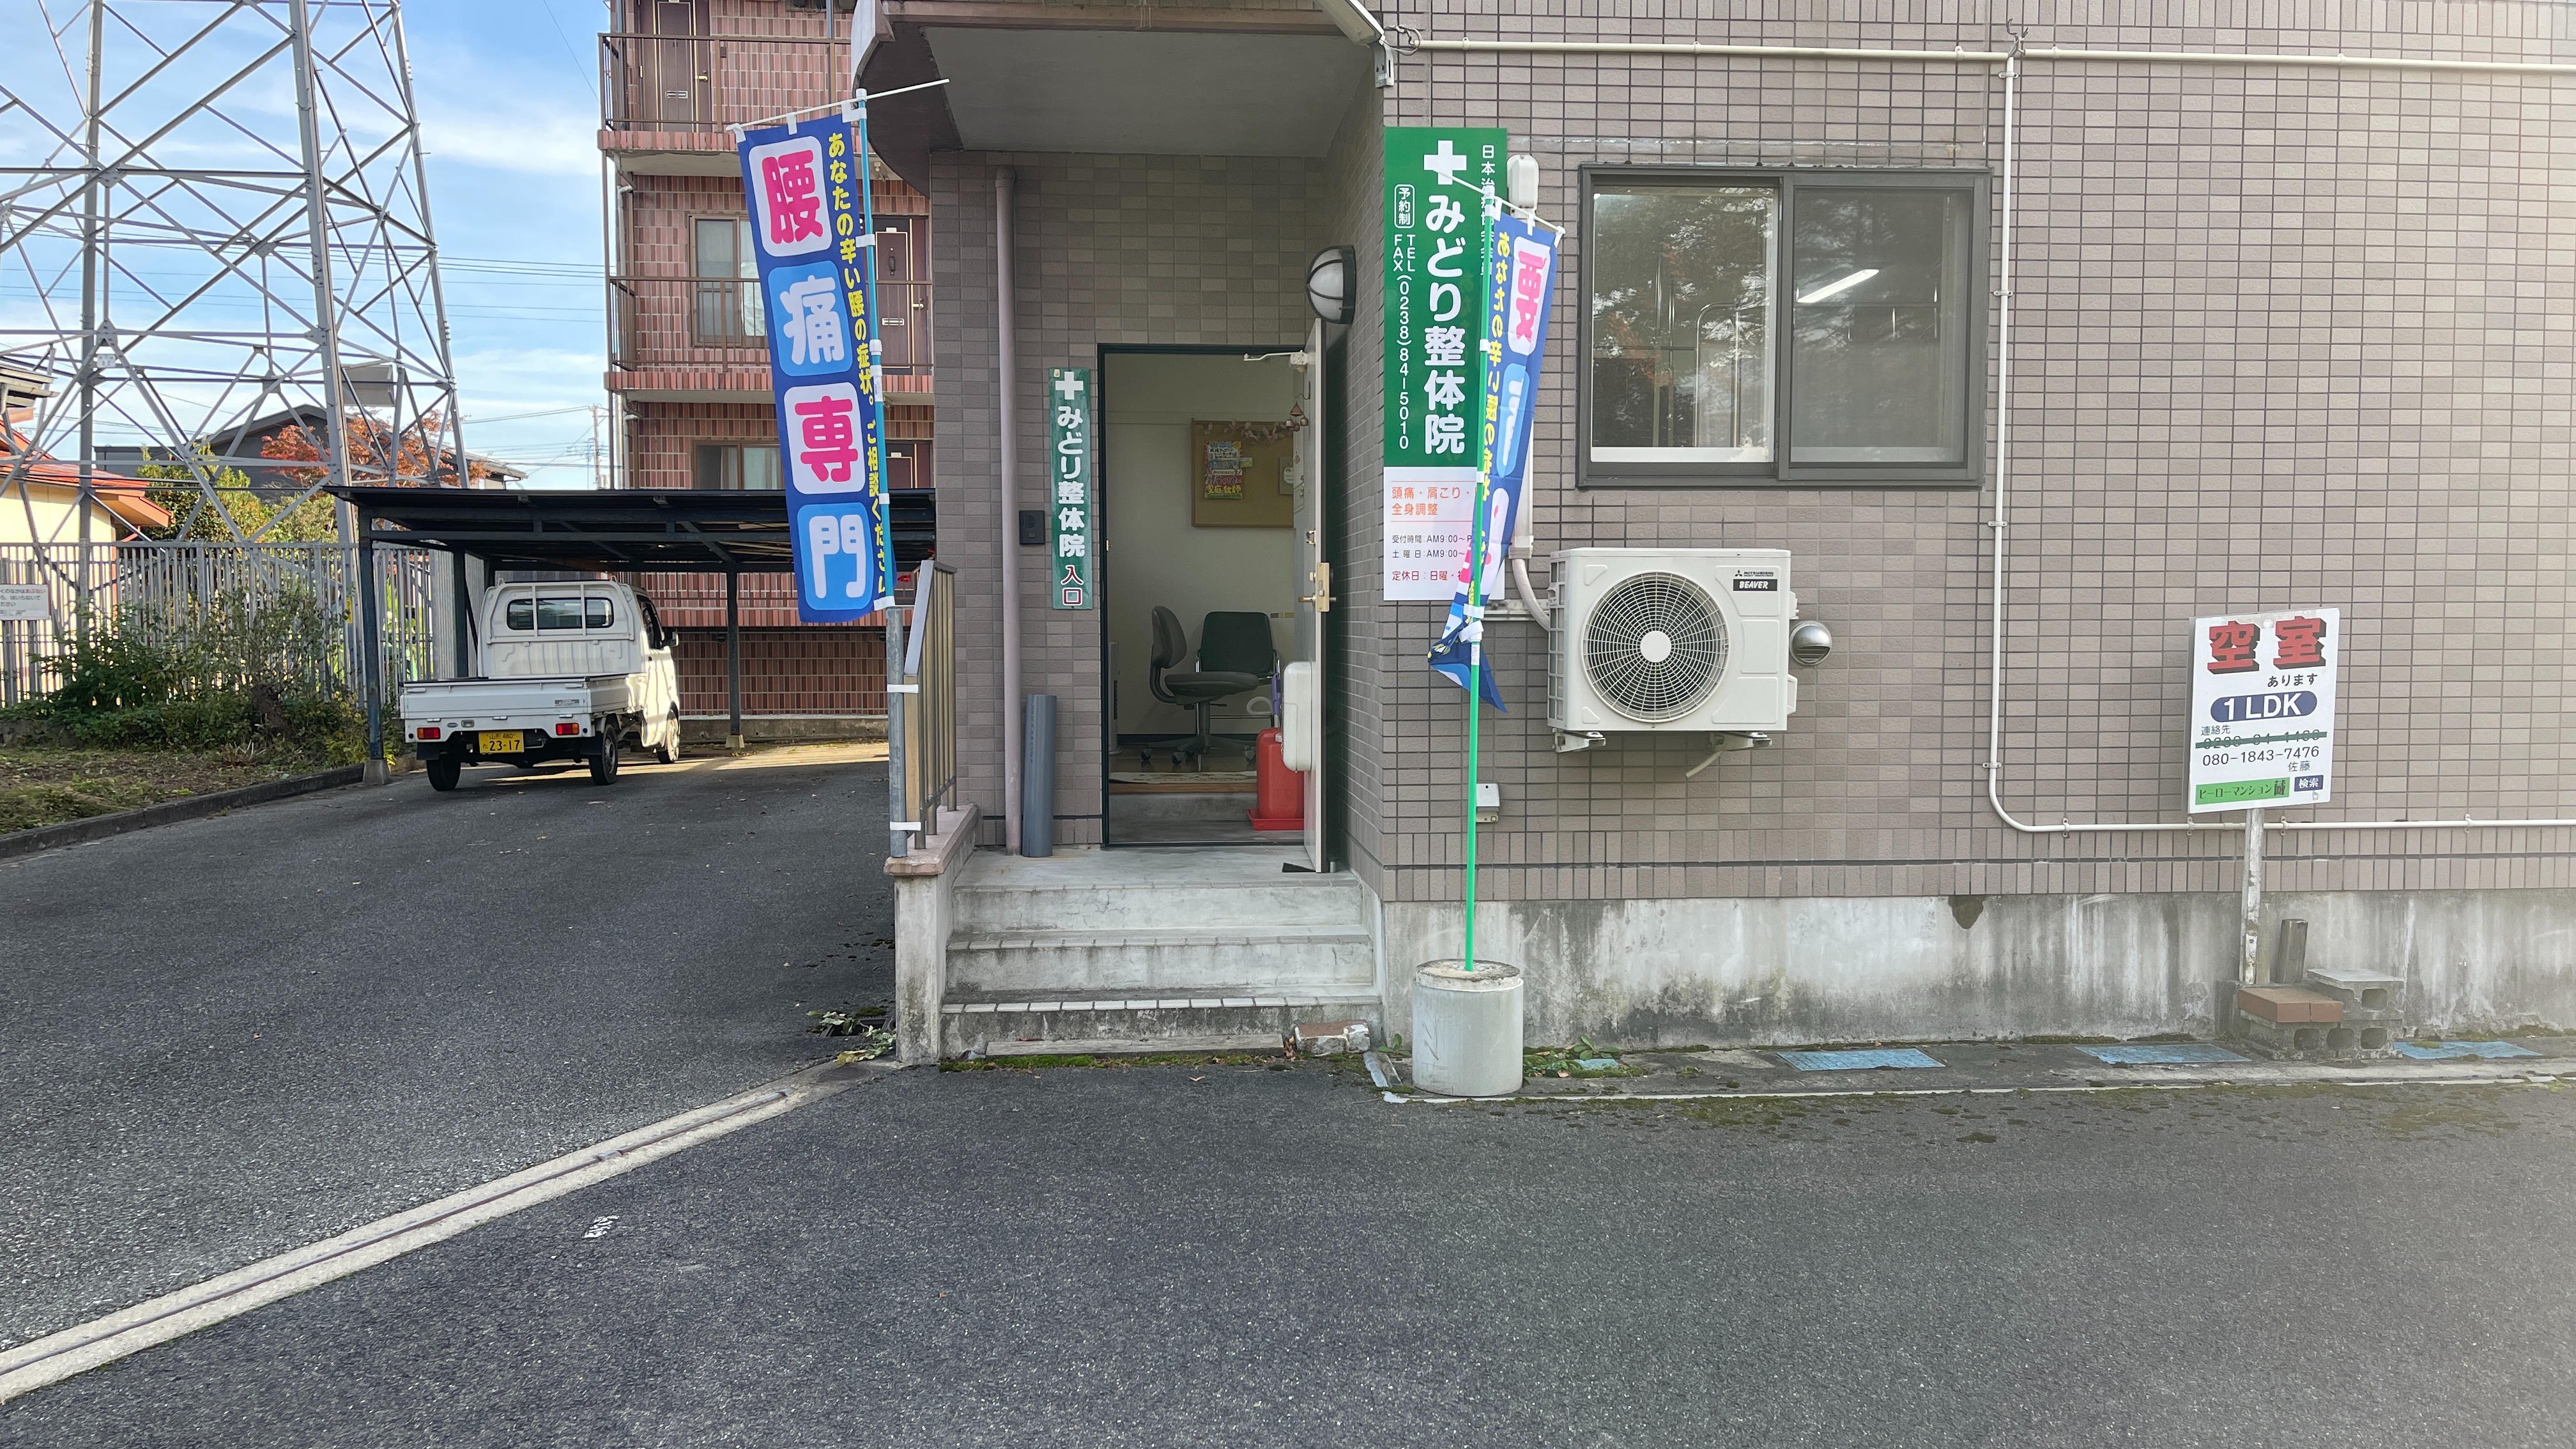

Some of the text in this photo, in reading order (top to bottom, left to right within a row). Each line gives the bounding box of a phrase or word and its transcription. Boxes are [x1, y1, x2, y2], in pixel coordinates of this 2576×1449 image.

[1399, 188, 1411, 225] 予約制
[1393, 234, 1403, 272] FAX
[1407, 234, 1416, 272] TEL
[1424, 195, 1466, 454] みどり整体院
[762, 150, 866, 599] 腰痛専門
[1057, 406, 1085, 558] みどり整体院
[1392, 503, 1438, 515] 全身調整
[1061, 565, 1084, 606] 入口
[1739, 581, 1768, 589] BEAVER
[2207, 616, 2327, 675] 空室
[2267, 673, 2318, 687] あります
[2201, 724, 2231, 736] 連絡先
[489, 740, 520, 751] 23-17
[2203, 746, 2319, 766] 080-1843-7476
[2288, 760, 2311, 772] 佐藤
[2299, 777, 2319, 789] 検索
